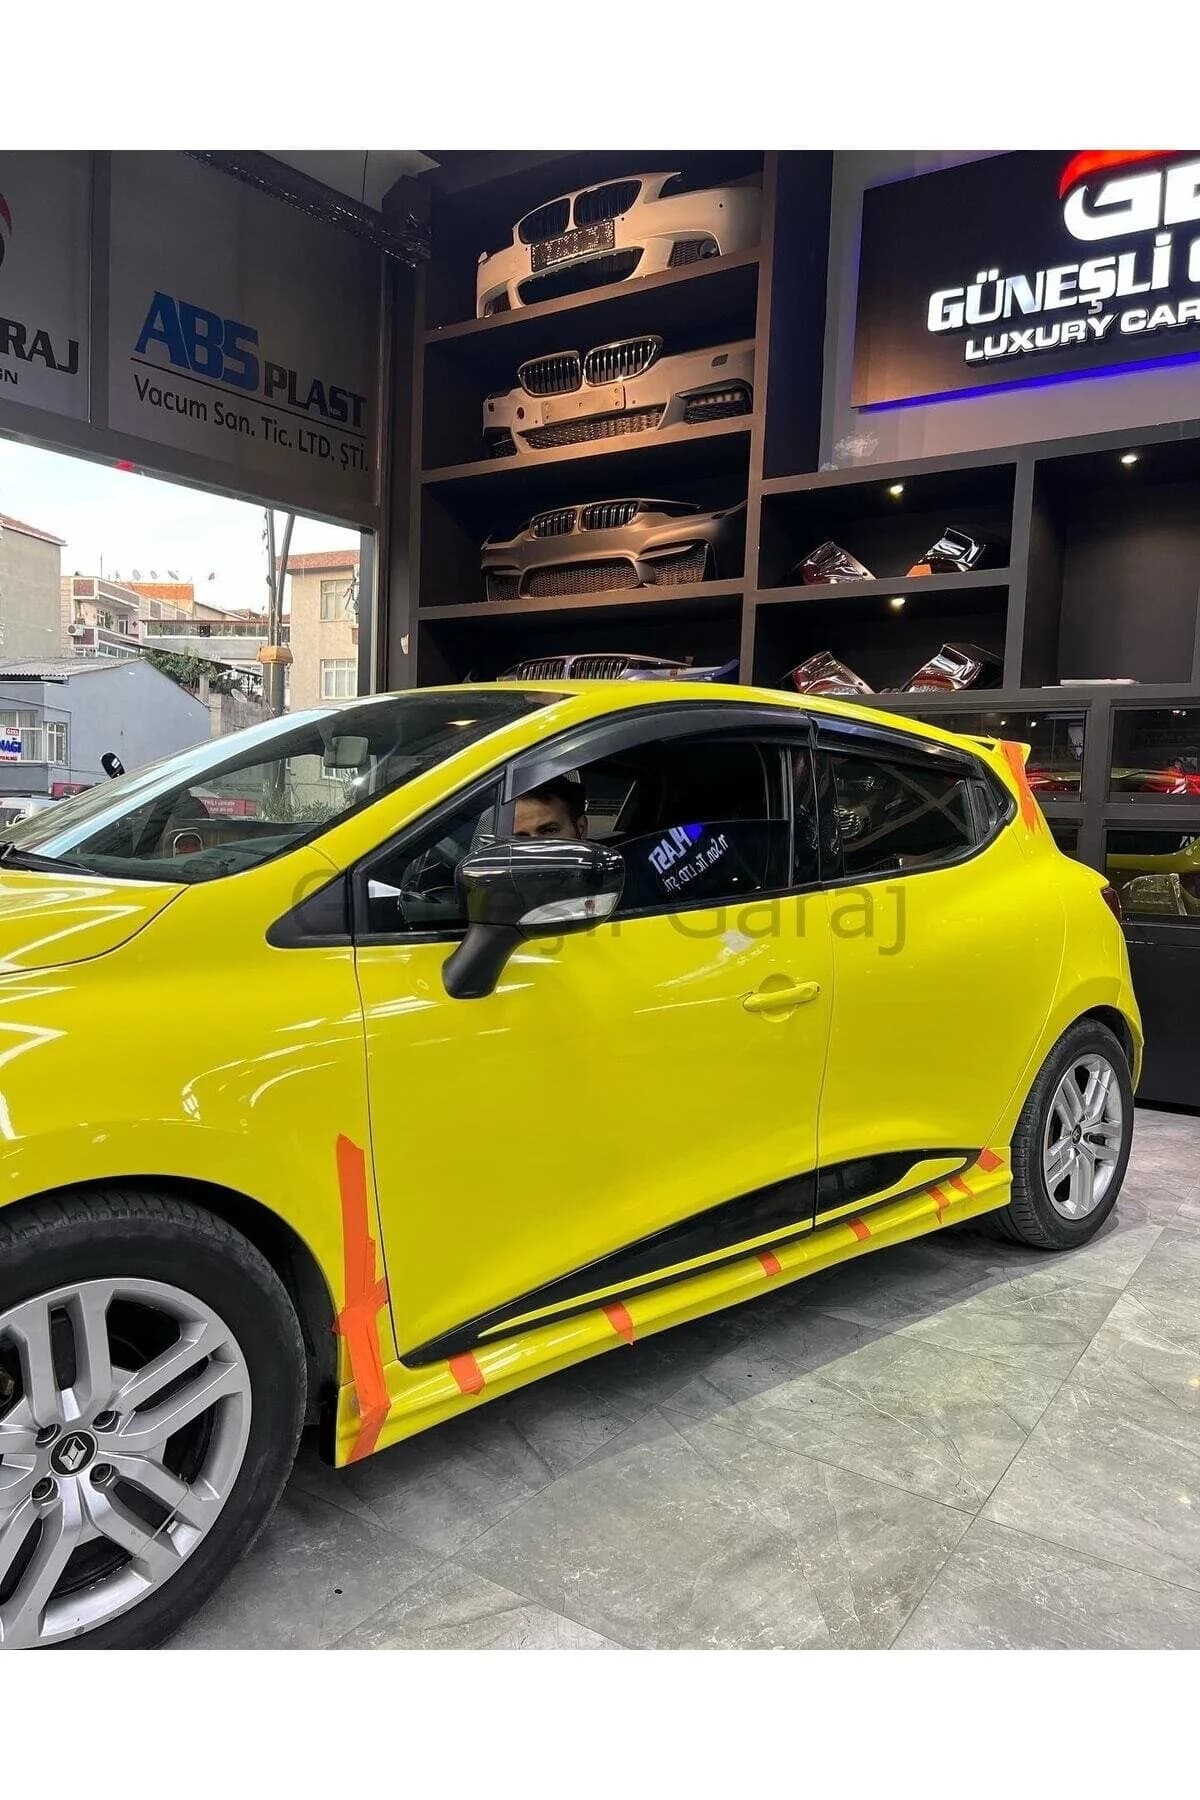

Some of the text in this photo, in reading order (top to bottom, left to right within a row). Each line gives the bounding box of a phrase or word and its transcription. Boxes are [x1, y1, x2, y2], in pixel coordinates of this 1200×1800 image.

[927, 233, 1173, 333] GÜNEŞLİ
[134, 291, 368, 428] ABS PLAST
[964, 312, 1120, 363] LUXURY
[134, 375, 369, 472] Vacum San. Tic. LTD. ŞTİ.
